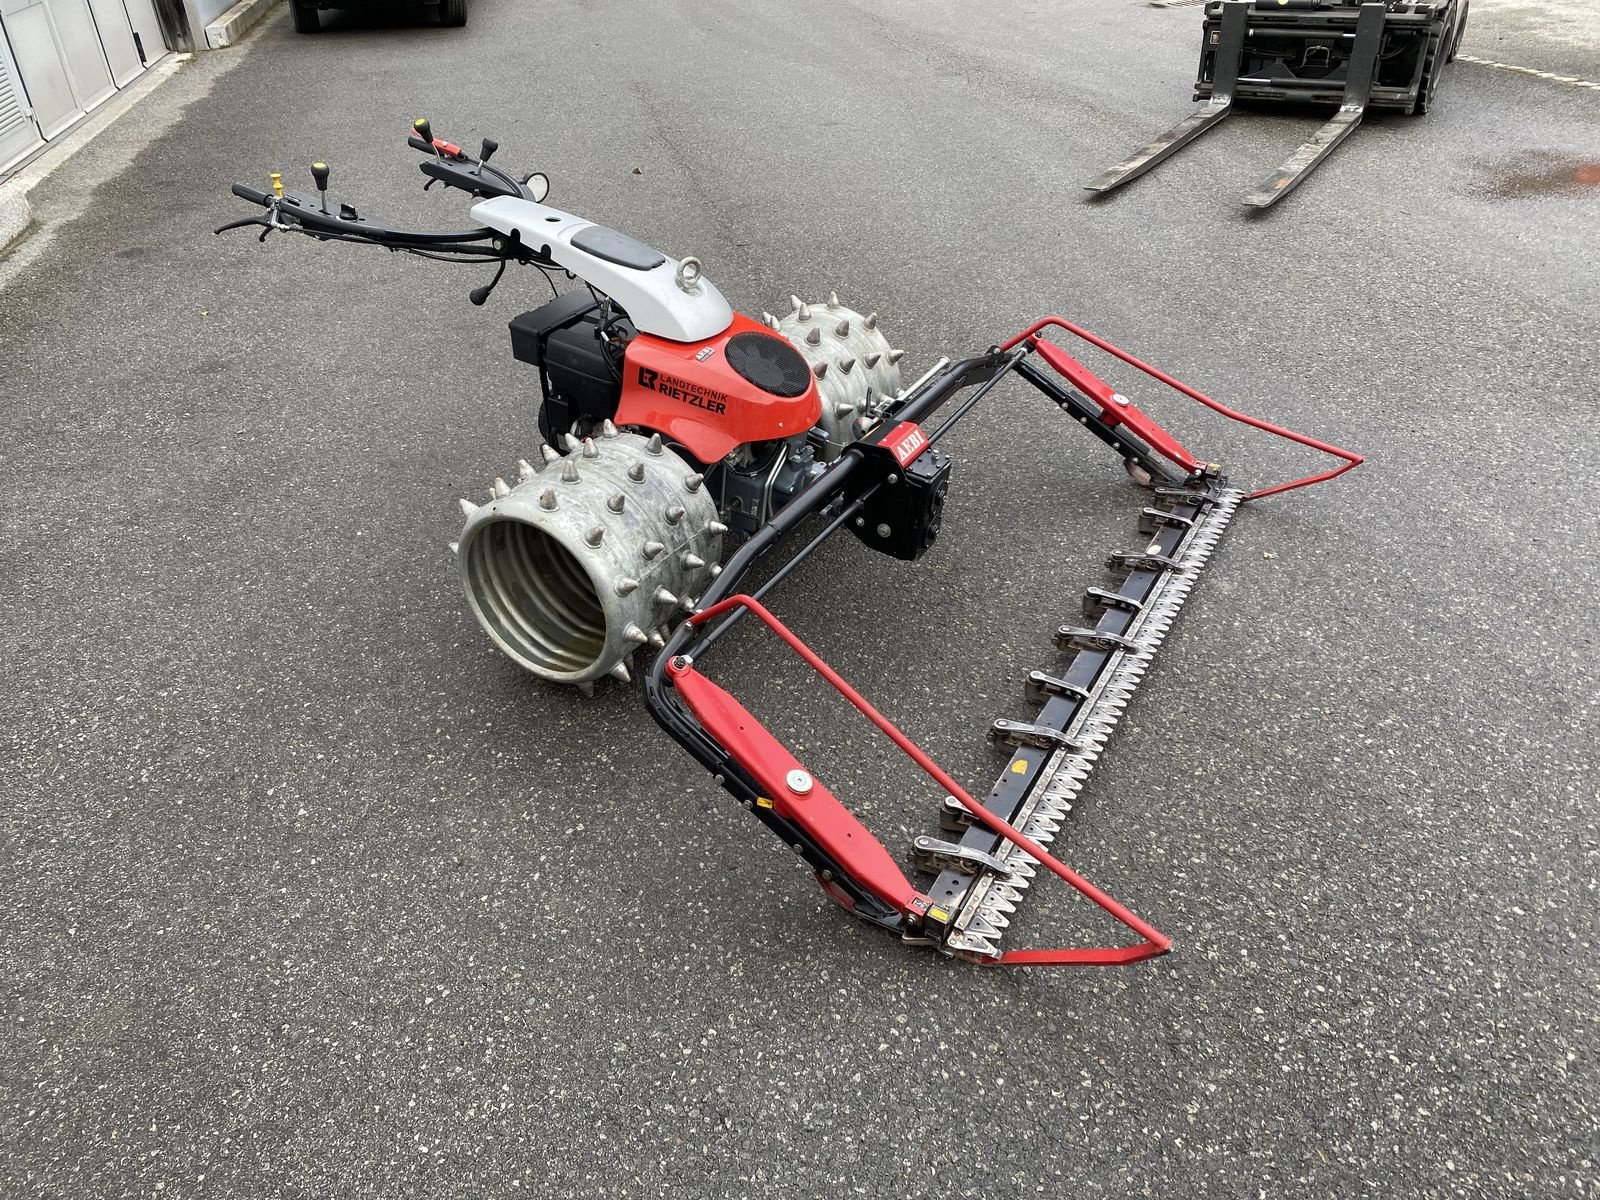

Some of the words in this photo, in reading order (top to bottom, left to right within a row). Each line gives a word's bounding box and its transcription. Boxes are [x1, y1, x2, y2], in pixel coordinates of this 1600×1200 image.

[659, 383, 726, 415] RIETZLER
[660, 374, 728, 402] LANDTECHNIK
[896, 429, 925, 462] AEBI
